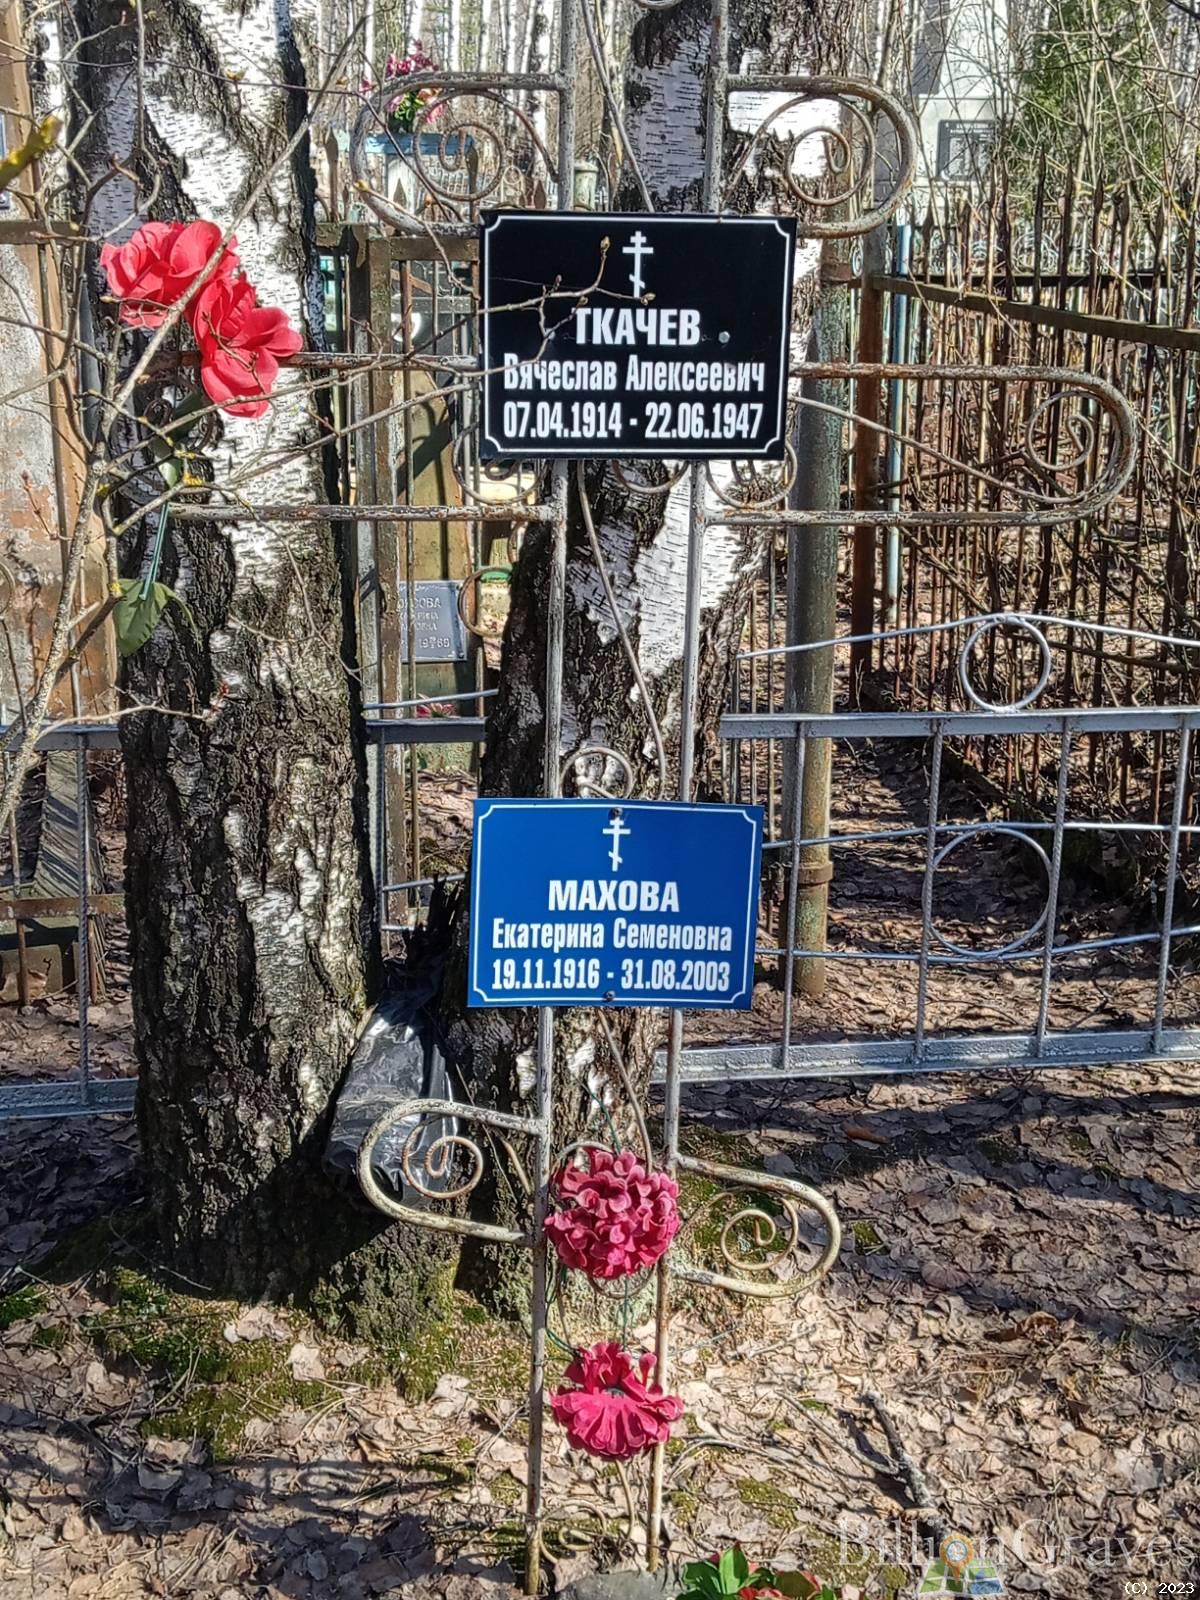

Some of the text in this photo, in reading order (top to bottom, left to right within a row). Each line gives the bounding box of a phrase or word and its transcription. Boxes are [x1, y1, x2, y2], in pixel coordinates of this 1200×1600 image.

[572, 307, 701, 345] ТКАЧЕВ
[503, 352, 765, 391] Вячеслав Алексеевич
[503, 401, 622, 438] 07.04.1914
[645, 402, 764, 439] 22.06.1947
[548, 880, 680, 912] МАХОВА
[492, 917, 733, 953] Екатерина Семеновна
[491, 958, 601, 990] 19.11.1916
[620, 959, 731, 992] 31.08.2003
